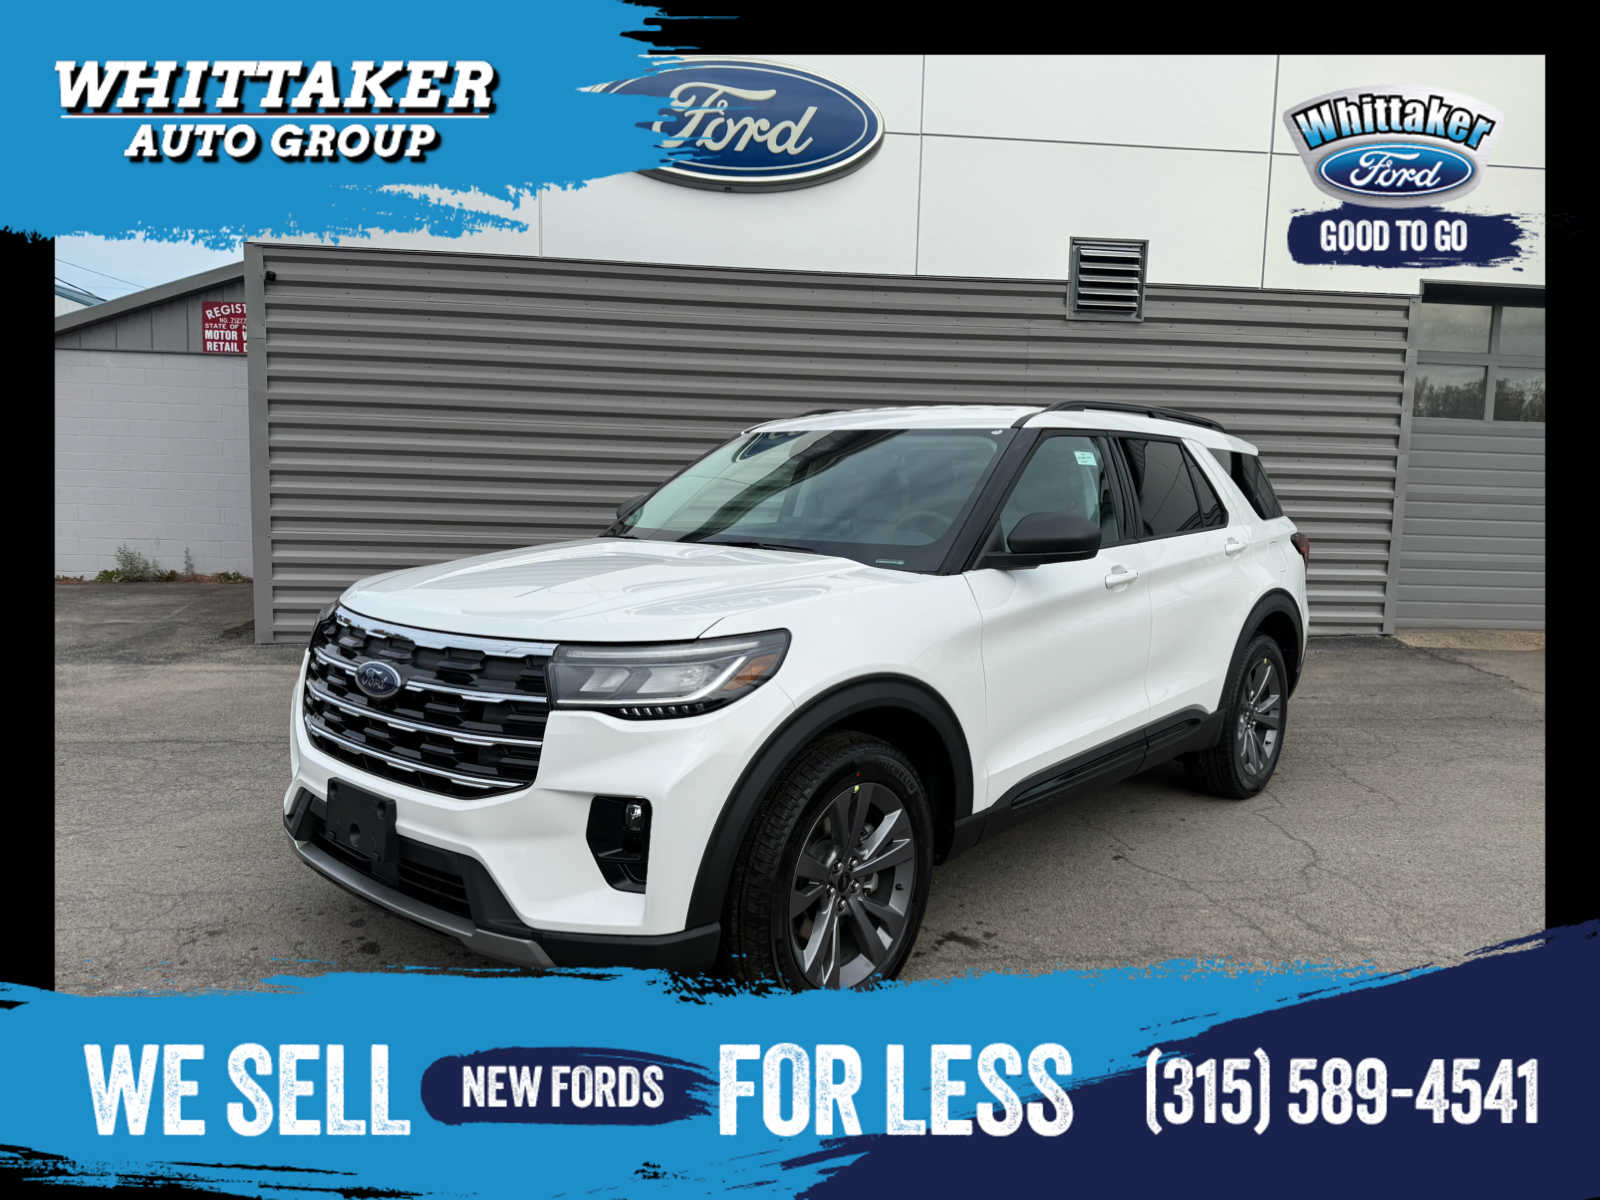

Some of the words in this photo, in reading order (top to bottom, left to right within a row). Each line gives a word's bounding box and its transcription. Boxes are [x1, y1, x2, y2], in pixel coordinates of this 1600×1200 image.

[650, 81, 818, 156] Ford
[204, 330, 238, 341] MOTOR
[206, 341, 240, 353] RETAIL
